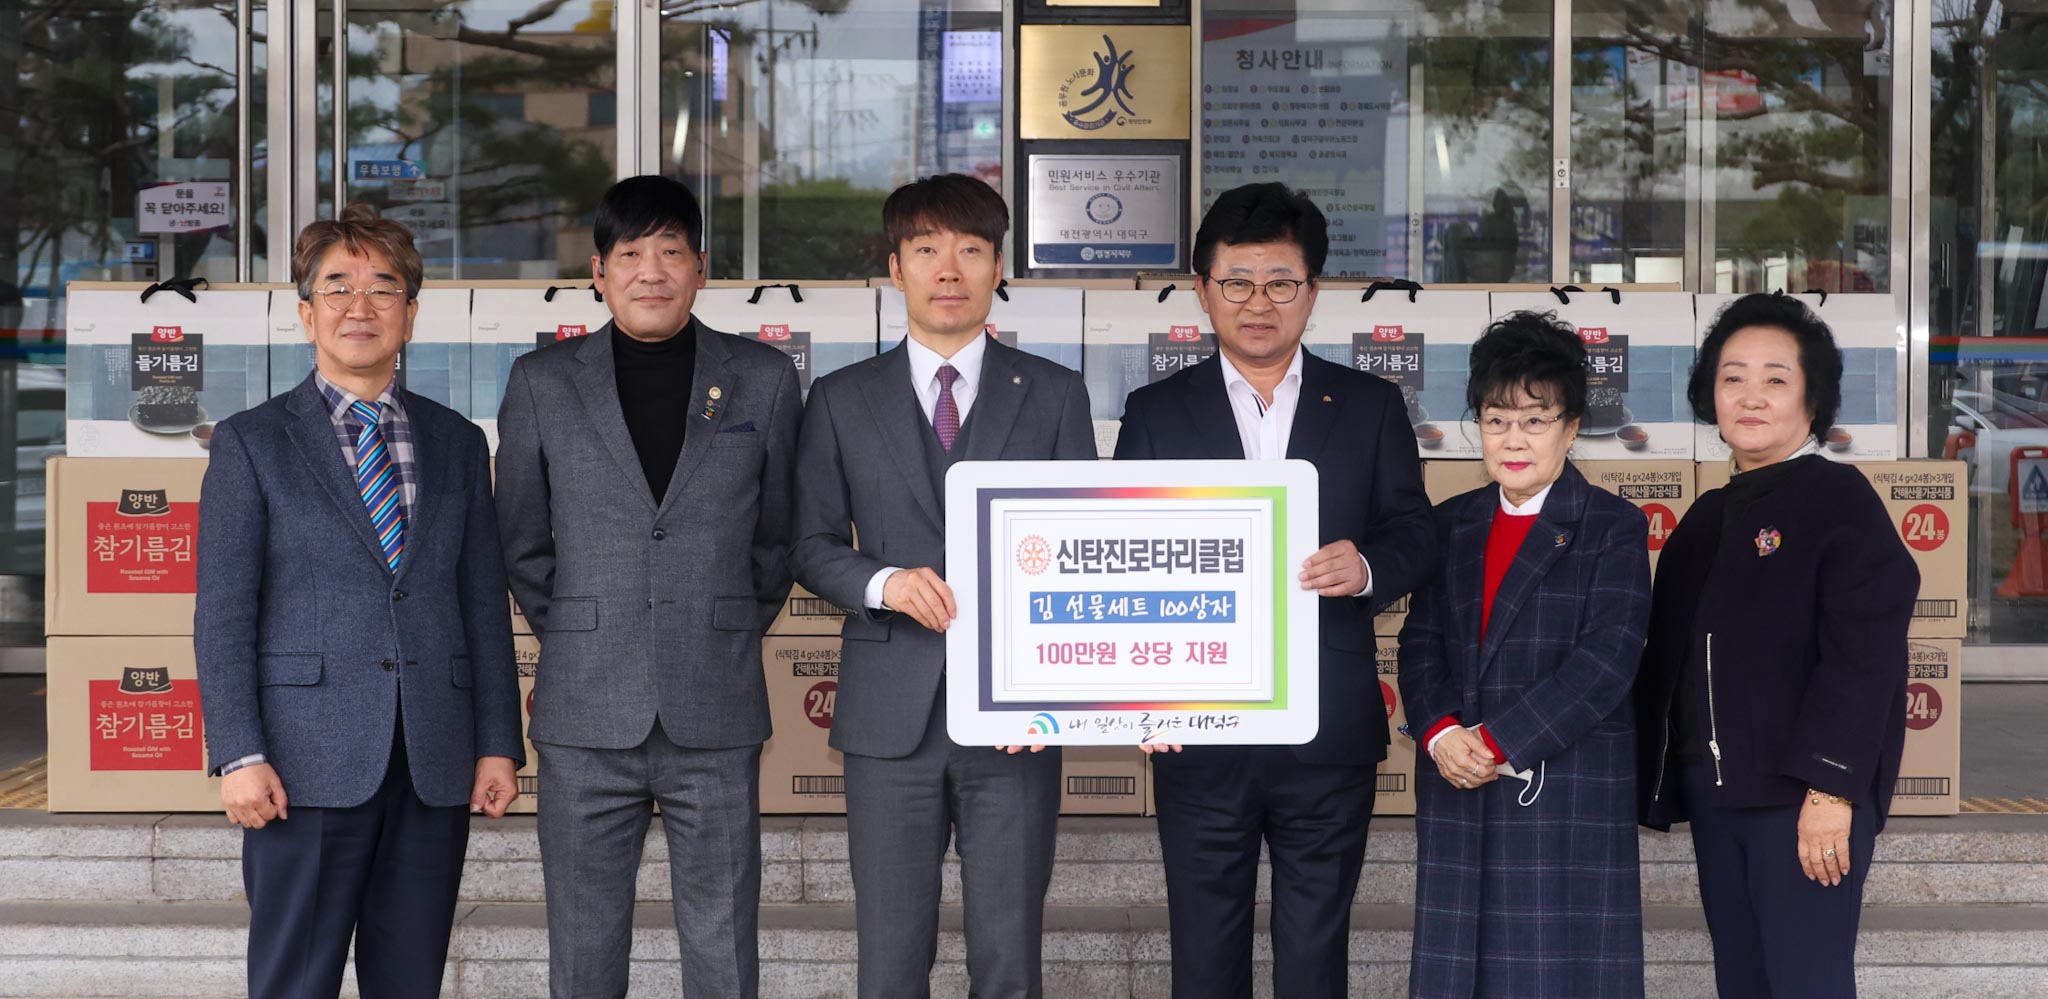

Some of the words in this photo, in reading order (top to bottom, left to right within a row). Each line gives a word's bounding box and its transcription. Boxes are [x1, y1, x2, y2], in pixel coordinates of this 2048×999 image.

[1236, 50, 1323, 70] 청사안내
[1066, 68, 1095, 85] 노사문화
[1048, 170, 1107, 183] 민원서비스
[1114, 170, 1160, 184] 우수기관
[175, 189, 194, 199] 문을
[144, 202, 156, 214] 꼭
[161, 202, 225, 215] 닫아주세요!
[1060, 229, 1112, 239] 대전광역시
[1117, 229, 1148, 239] 대덕구
[157, 328, 177, 339] 양반
[562, 326, 581, 337] 양반
[765, 327, 784, 337] 양반
[1174, 328, 1193, 338] 양반
[1379, 328, 1397, 338] 양반
[1583, 330, 1601, 340] 양반
[136, 354, 198, 371] 들기름김
[1152, 353, 1213, 371] 참기름
[1356, 353, 1418, 371] 참기름김
[1620, 485, 1680, 498] 건해산물가공식품
[1893, 487, 1953, 499] 건해산물가공식품
[128, 493, 159, 509] 양반
[93, 535, 191, 562] 참기름김
[1056, 538, 1244, 574] 신탄진로타리클럽
[1033, 596, 1054, 620] 김
[1066, 594, 1149, 620] 선물세트
[1159, 594, 1232, 619] 100상자
[1036, 642, 1117, 665] 100만원
[1130, 642, 1173, 665] 상당
[1185, 641, 1228, 665] 지원
[795, 663, 839, 676] 건해산물가공
[1908, 665, 1947, 677] 물가공식품
[130, 671, 160, 687] 양반
[96, 712, 193, 739] 참기름김
[1069, 718, 1088, 730] 내
[1094, 716, 1134, 734] 일상이
[1138, 712, 1183, 744] 즐거운
[1188, 714, 1240, 731] 대덕구
